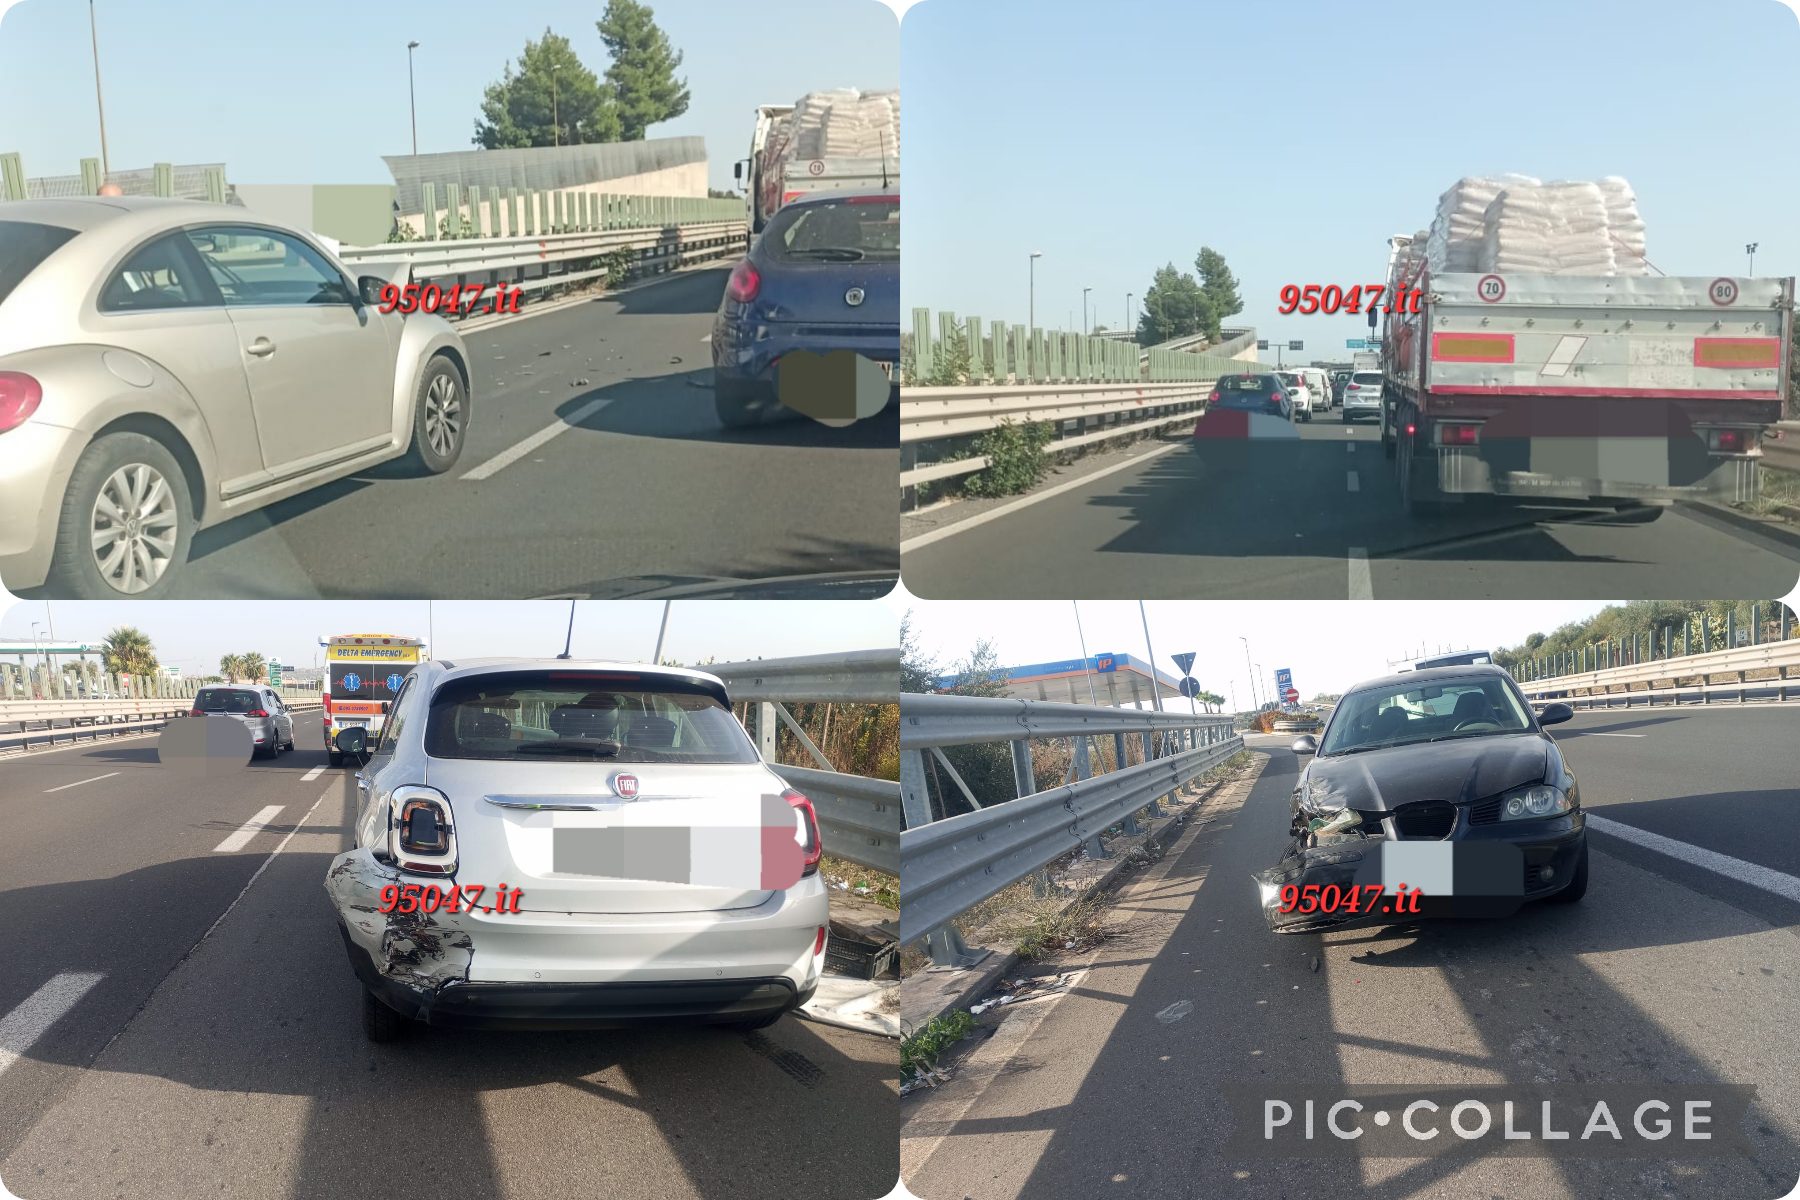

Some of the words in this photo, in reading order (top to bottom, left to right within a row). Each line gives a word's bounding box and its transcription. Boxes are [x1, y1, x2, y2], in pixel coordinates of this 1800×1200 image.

[1485, 282, 1500, 295] 70
[1717, 286, 1731, 298] 80
[337, 648, 359, 657] DELTA
[361, 648, 402, 657] EMERGENCY
[1098, 658, 1112, 670] IP
[1279, 673, 1290, 683] IP
[620, 779, 636, 791] FIAT
